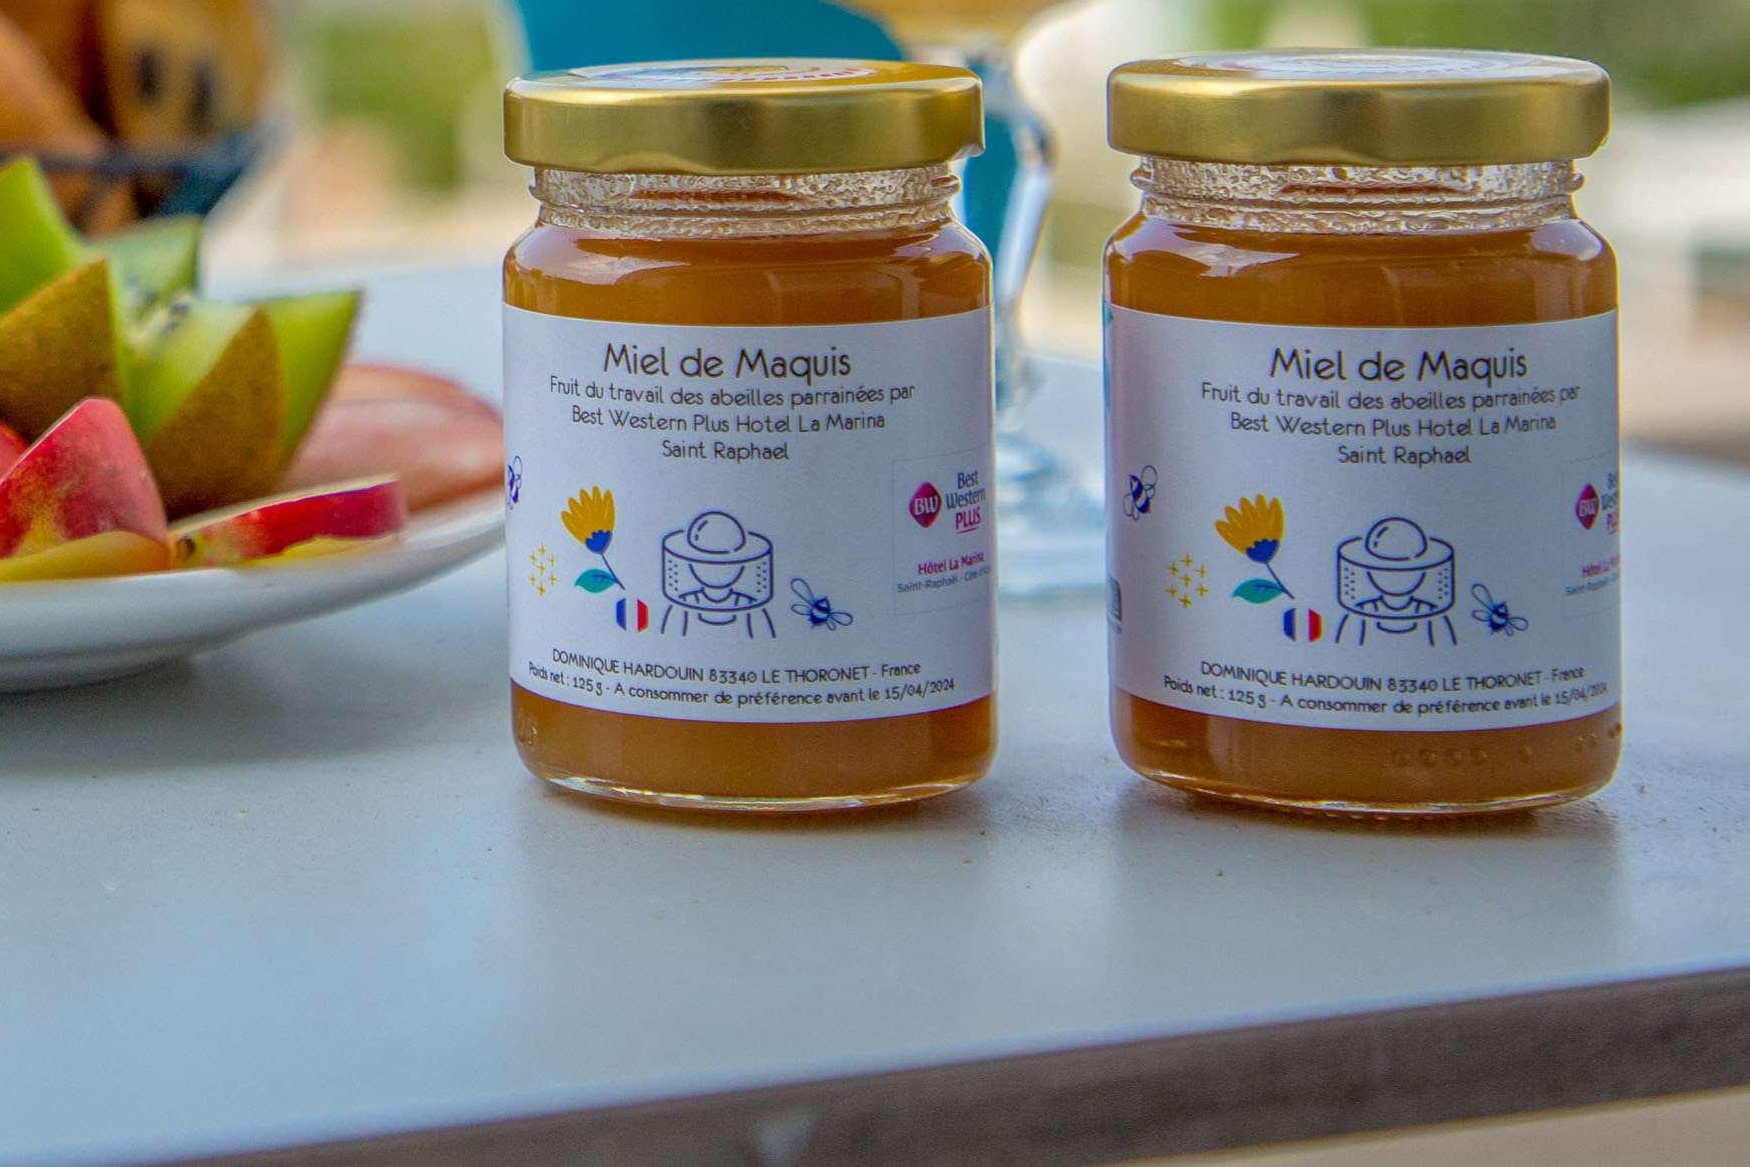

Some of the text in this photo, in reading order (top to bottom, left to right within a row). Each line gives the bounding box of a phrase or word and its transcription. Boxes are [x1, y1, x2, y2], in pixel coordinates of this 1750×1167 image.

[603, 343, 852, 386] Miel de Maquis
[1269, 347, 1528, 388] Miel de Maquis
[550, 375, 915, 410] Fruit du travail des abeilles parrainées par
[1201, 382, 1581, 412] Fruit du travail des abeilles parrainées par
[572, 405, 885, 433] Best Western Plus Hotel La Marina
[1231, 411, 1556, 437] Best Western Plus Hotel La Marina
[661, 439, 790, 465] Saint Raphael
[1337, 445, 1472, 470] Saint Raphael
[957, 470, 979, 490] Best
[914, 495, 939, 516] BW
[955, 507, 981, 530] PLUS
[552, 648, 620, 676] DOMINIQUE
[623, 662, 704, 682] HARDOUIN
[709, 669, 757, 684] 83340
[762, 669, 780, 684] LE
[785, 665, 870, 684] THORONET
[881, 663, 922, 679] France
[1201, 661, 1287, 687] DOMINIQUE
[1292, 673, 1383, 692] HARDOUIN
[1387, 678, 1439, 694] 83340
[1442, 677, 1462, 692] LE
[1465, 671, 1544, 691] THORONET
[528, 661, 548, 680] Poids
[550, 671, 565, 686] net
[572, 677, 594, 693] 125
[613, 683, 625, 697] A
[628, 686, 709, 704] consommer
[714, 691, 735, 704] de
[737, 692, 823, 709] préférence
[826, 688, 865, 705] avant
[868, 688, 882, 702] le
[884, 677, 955, 702] 15/04/2024
[1163, 674, 1194, 694] Poids
[1196, 684, 1218, 699] net
[1228, 689, 1256, 705] 125
[1280, 694, 1294, 708] A
[1298, 696, 1387, 714] consommer
[1393, 699, 1413, 714] de
[1417, 699, 1501, 718] préférence
[1504, 696, 1539, 711] avant
[1541, 693, 1551, 707] le
